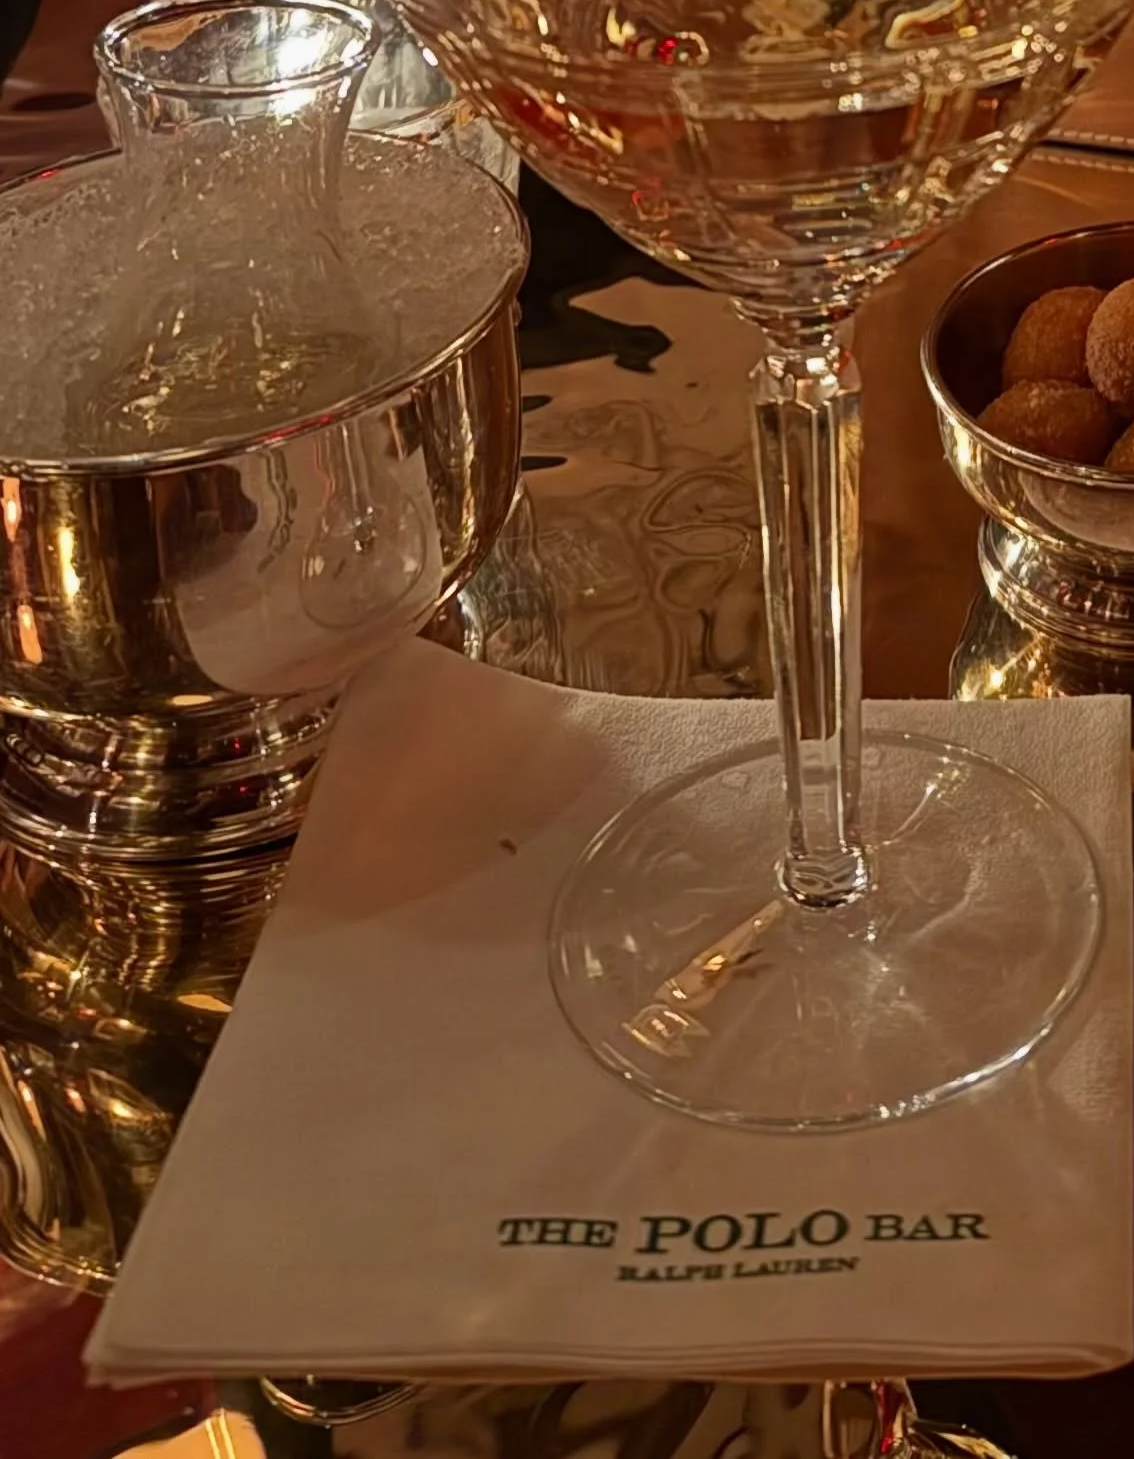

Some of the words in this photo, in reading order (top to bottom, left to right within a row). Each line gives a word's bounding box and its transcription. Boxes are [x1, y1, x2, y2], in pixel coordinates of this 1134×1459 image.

[499, 1217, 619, 1248] THE
[634, 1209, 850, 1255] POLO
[864, 1213, 992, 1241] BAR
[616, 1264, 726, 1281] RALPH
[731, 1257, 860, 1278] LAUREN
